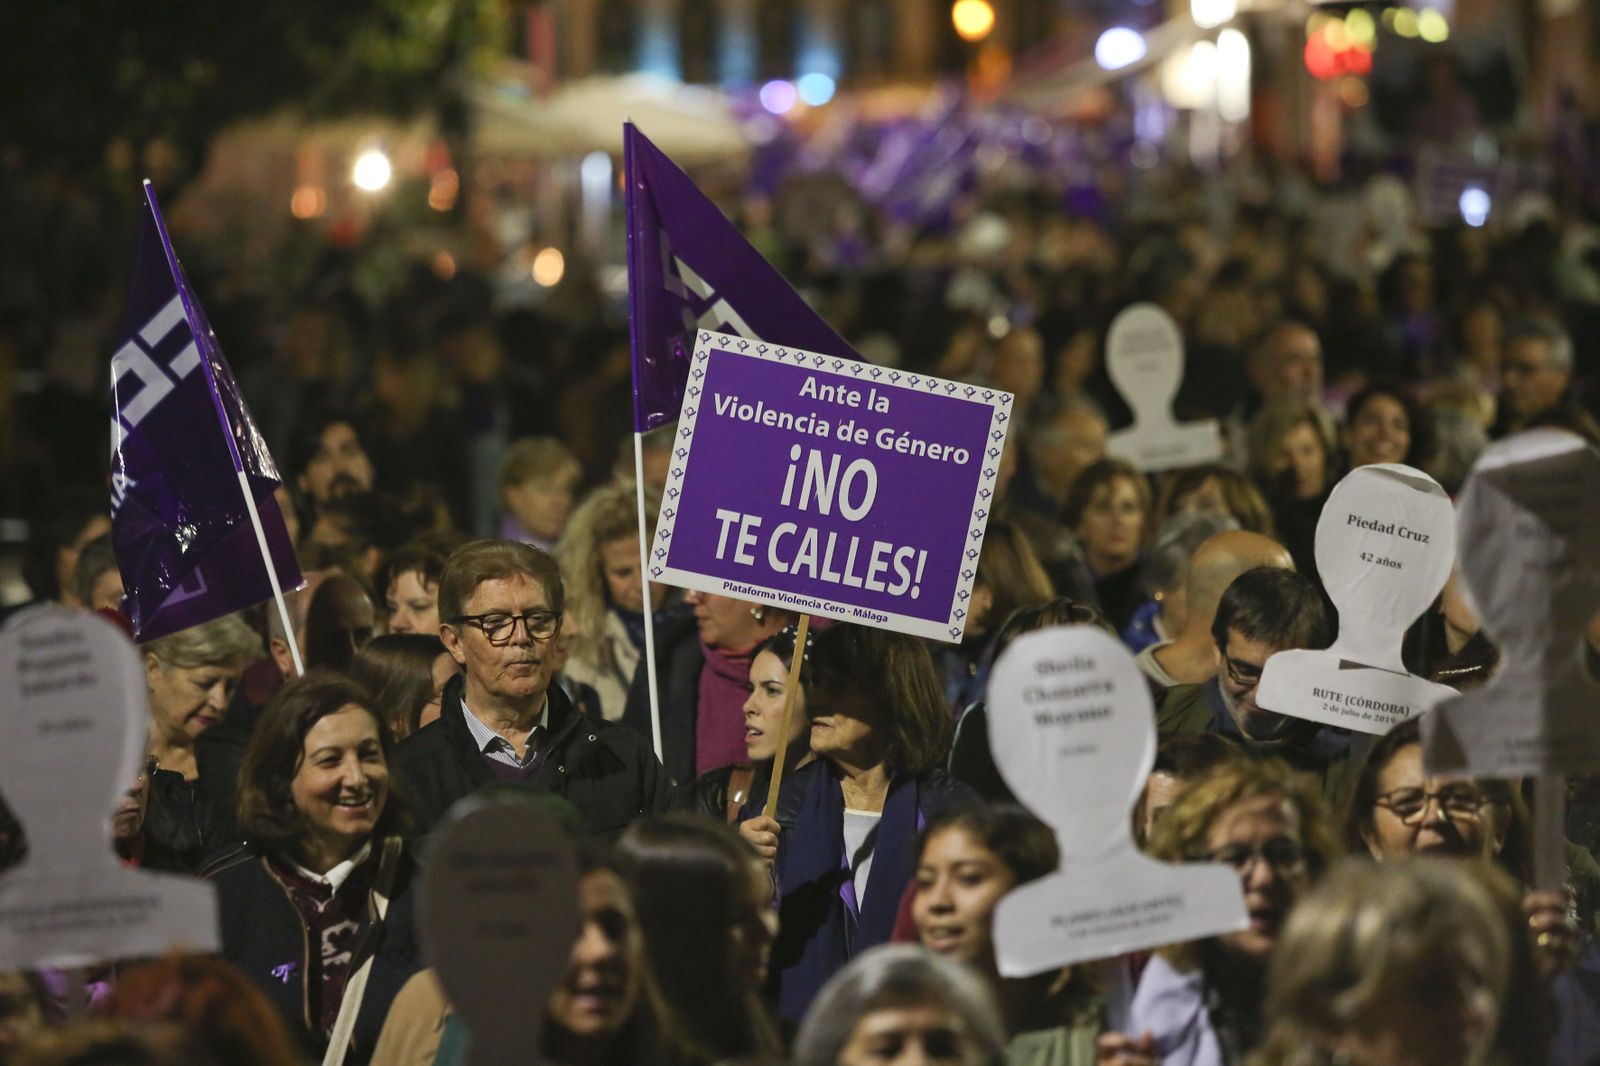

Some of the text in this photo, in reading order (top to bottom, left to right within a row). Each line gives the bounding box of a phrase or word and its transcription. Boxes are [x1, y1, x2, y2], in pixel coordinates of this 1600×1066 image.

[799, 376, 890, 413] Ante la
[714, 393, 970, 465] Violencia de Género
[780, 443, 878, 522] ¡NO
[1347, 514, 1430, 544] Piedad Cruz
[714, 508, 928, 599] TE CALLES!
[1360, 552, 1403, 569] 42 años
[722, 581, 776, 600] Plataforma
[778, 593, 821, 609] Violencia
[823, 603, 846, 614] Cero
[853, 607, 888, 623] Málaga
[1312, 687, 1410, 717] RUTE (CÓRDOBA)
[1322, 703, 1396, 724] 2 de julio de 2019
